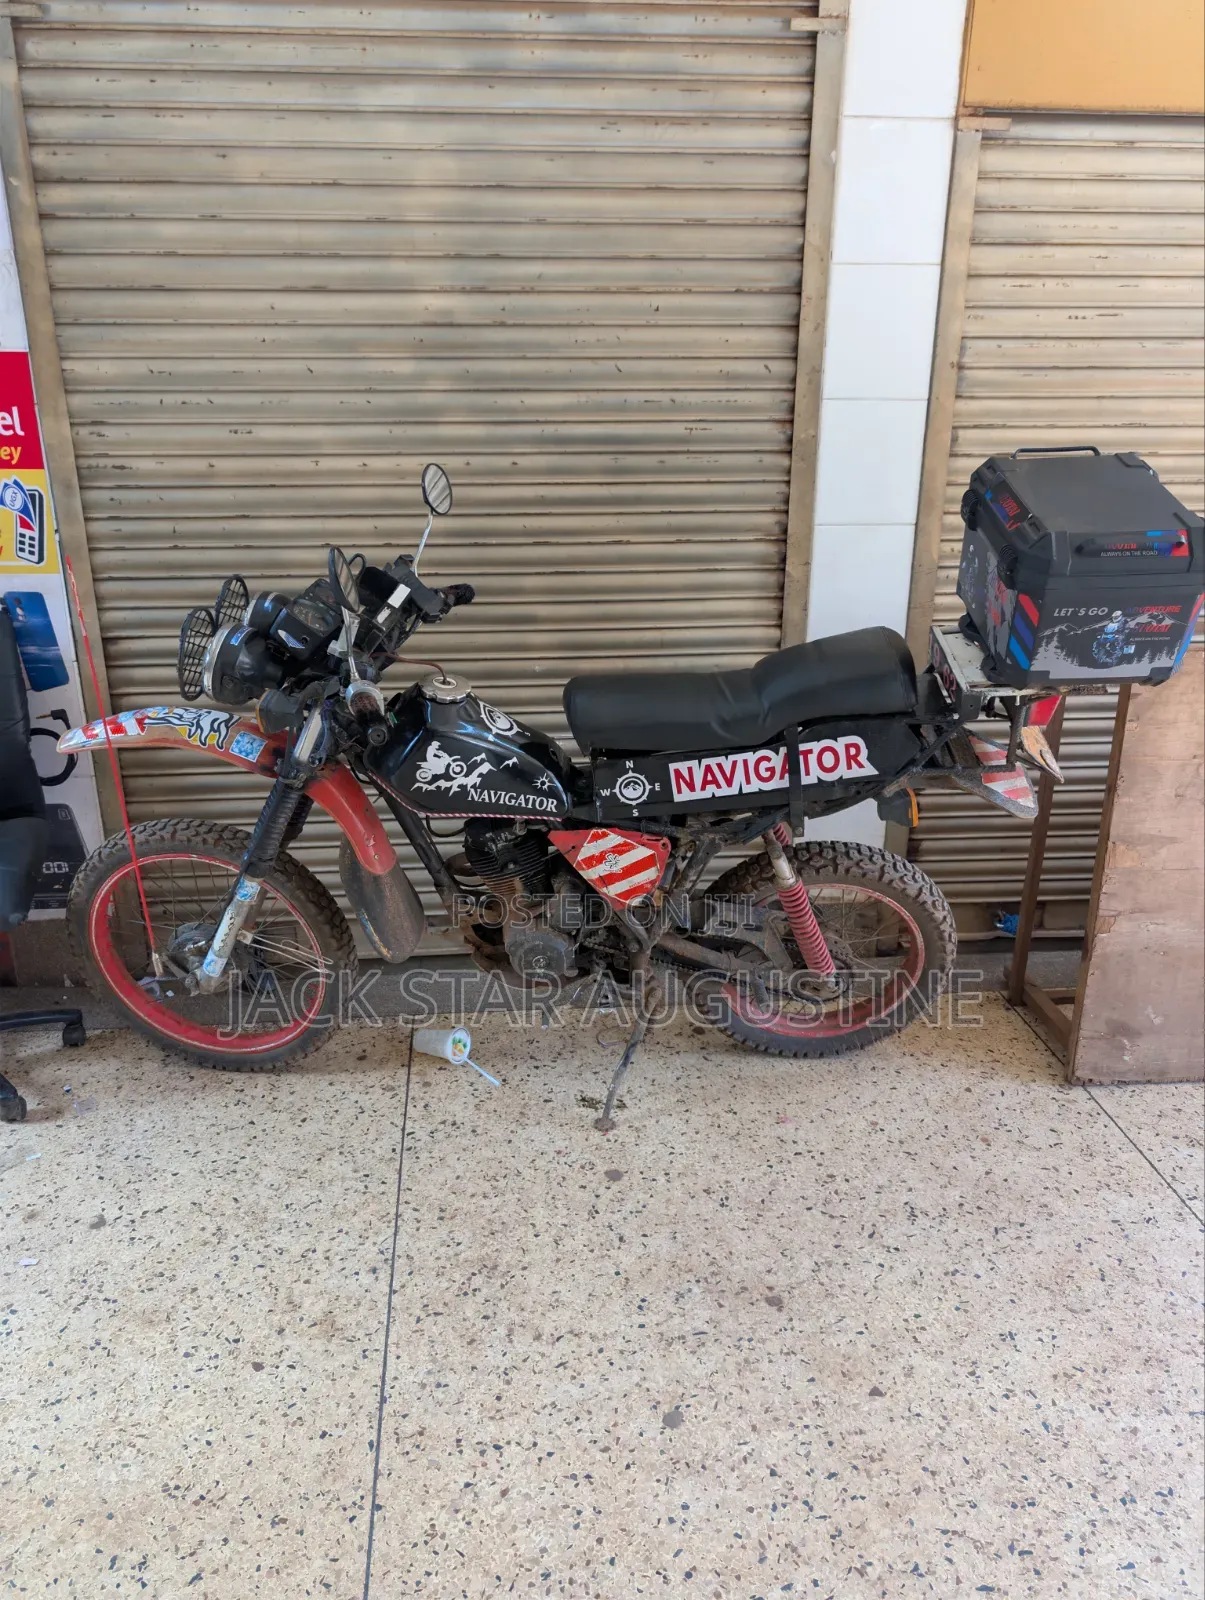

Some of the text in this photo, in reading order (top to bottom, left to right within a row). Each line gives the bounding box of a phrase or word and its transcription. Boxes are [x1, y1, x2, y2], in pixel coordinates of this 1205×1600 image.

[0, 406, 25, 436] el
[9, 490, 18, 507] UGX
[1088, 606, 1109, 616] GO
[625, 760, 634, 769] N
[655, 782, 661, 791] E
[600, 788, 611, 797] W
[467, 788, 558, 813] NAVIGATOR
[632, 809, 639, 817] S
